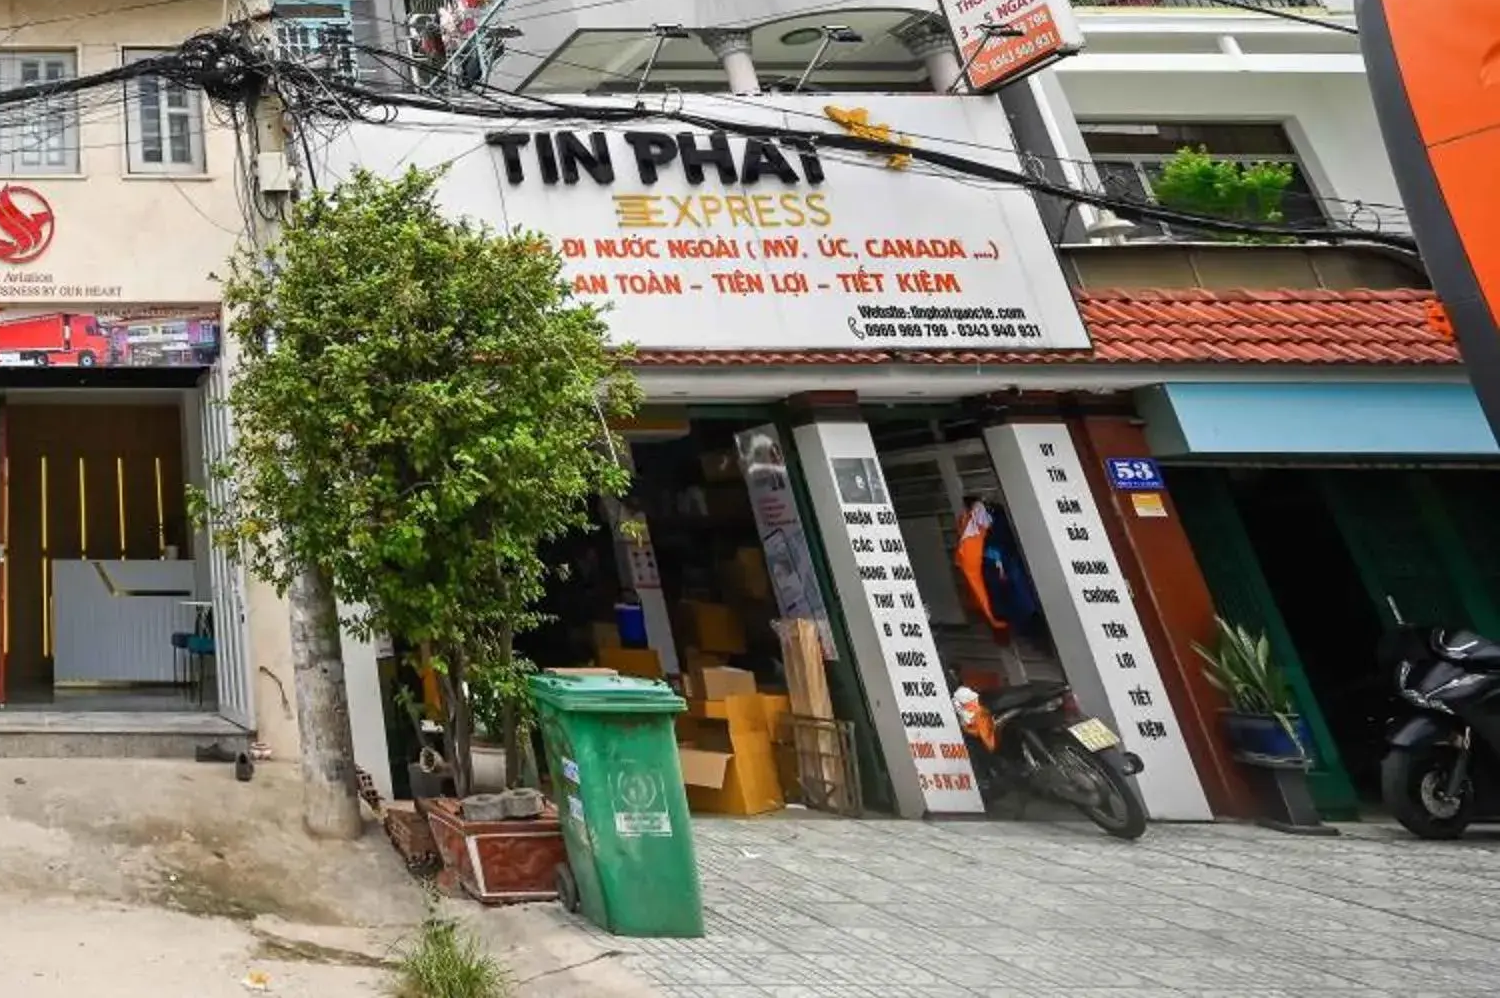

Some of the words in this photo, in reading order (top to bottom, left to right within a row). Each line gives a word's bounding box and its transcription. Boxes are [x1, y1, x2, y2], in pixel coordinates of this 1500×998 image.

[485, 130, 616, 186] TIN
[624, 130, 827, 186] PHAT
[611, 193, 833, 229] EXPRESS
[562, 238, 587, 259] ĐI
[594, 234, 661, 259] NƯỚC
[666, 234, 741, 260] NGOÀI
[864, 238, 968, 260] CANADA
[59, 285, 82, 298] OUR
[85, 285, 123, 298] HEART
[573, 273, 609, 295] AN
[615, 268, 683, 295] TOÀN
[711, 269, 765, 298] TIỆN
[772, 270, 809, 298] LỢI
[836, 265, 885, 294] TIẾT
[895, 269, 963, 298] KIỆM
[1113, 461, 1154, 480] 53
[901, 711, 945, 728] CANADA
